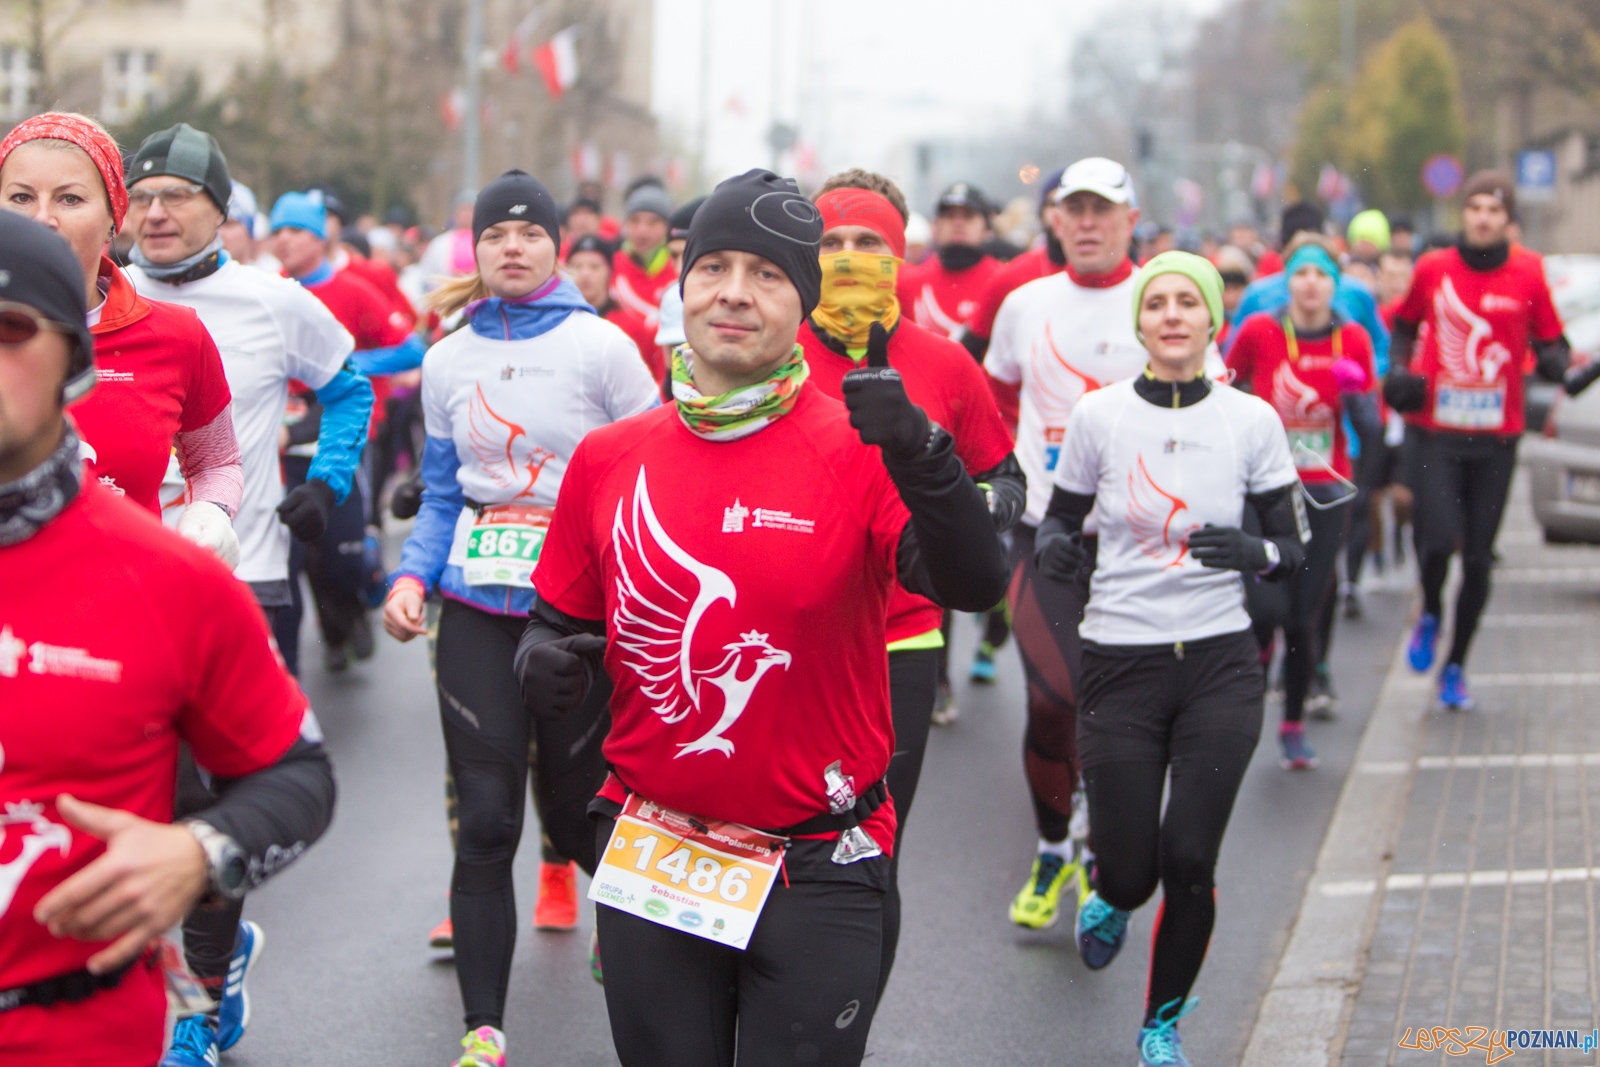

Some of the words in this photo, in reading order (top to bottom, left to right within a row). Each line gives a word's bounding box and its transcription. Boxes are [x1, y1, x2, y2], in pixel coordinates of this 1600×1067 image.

[508, 204, 528, 215] 4F
[752, 507, 762, 527] 1
[706, 830, 772, 858] RunPoland.org
[613, 835, 627, 850] D
[632, 834, 753, 903] 1486
[597, 889, 626, 904] LUXMED
[599, 882, 624, 896] GRUPA
[650, 884, 701, 908] Sebastian
